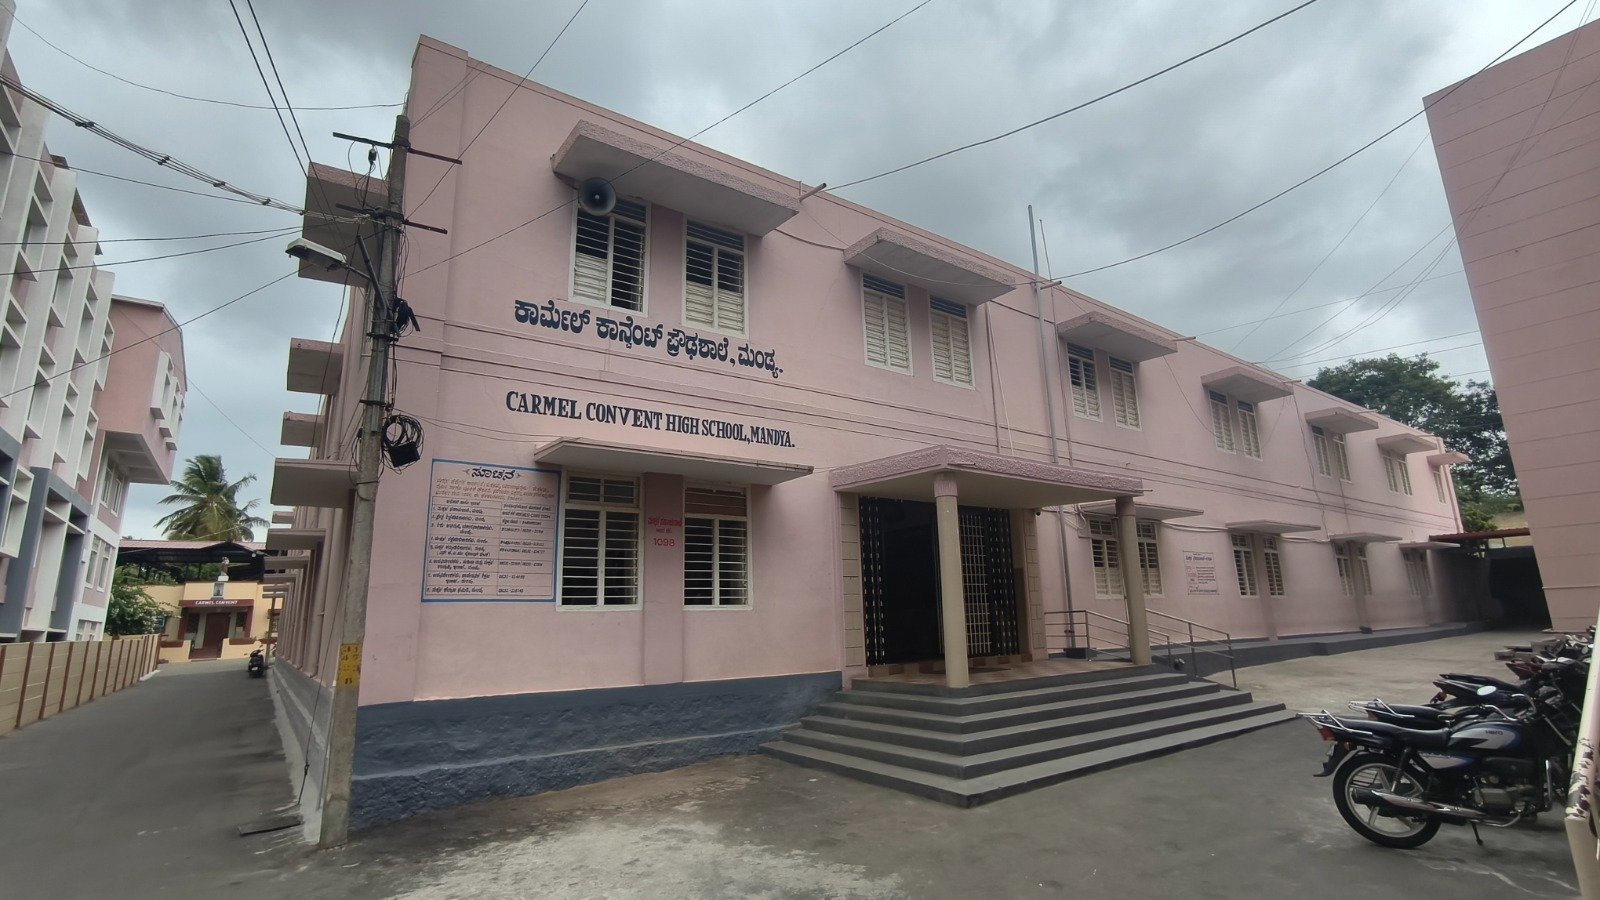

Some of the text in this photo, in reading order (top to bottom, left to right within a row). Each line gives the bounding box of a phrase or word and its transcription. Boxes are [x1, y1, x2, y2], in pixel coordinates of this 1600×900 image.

[505, 390, 582, 420] CARMEL
[585, 402, 663, 431] CONVENT
[665, 413, 700, 435] HIGH
[750, 426, 796, 448] MANDYA.
[471, 466, 516, 481] ಸೂಚನೆ
[653, 537, 675, 547] 1098
